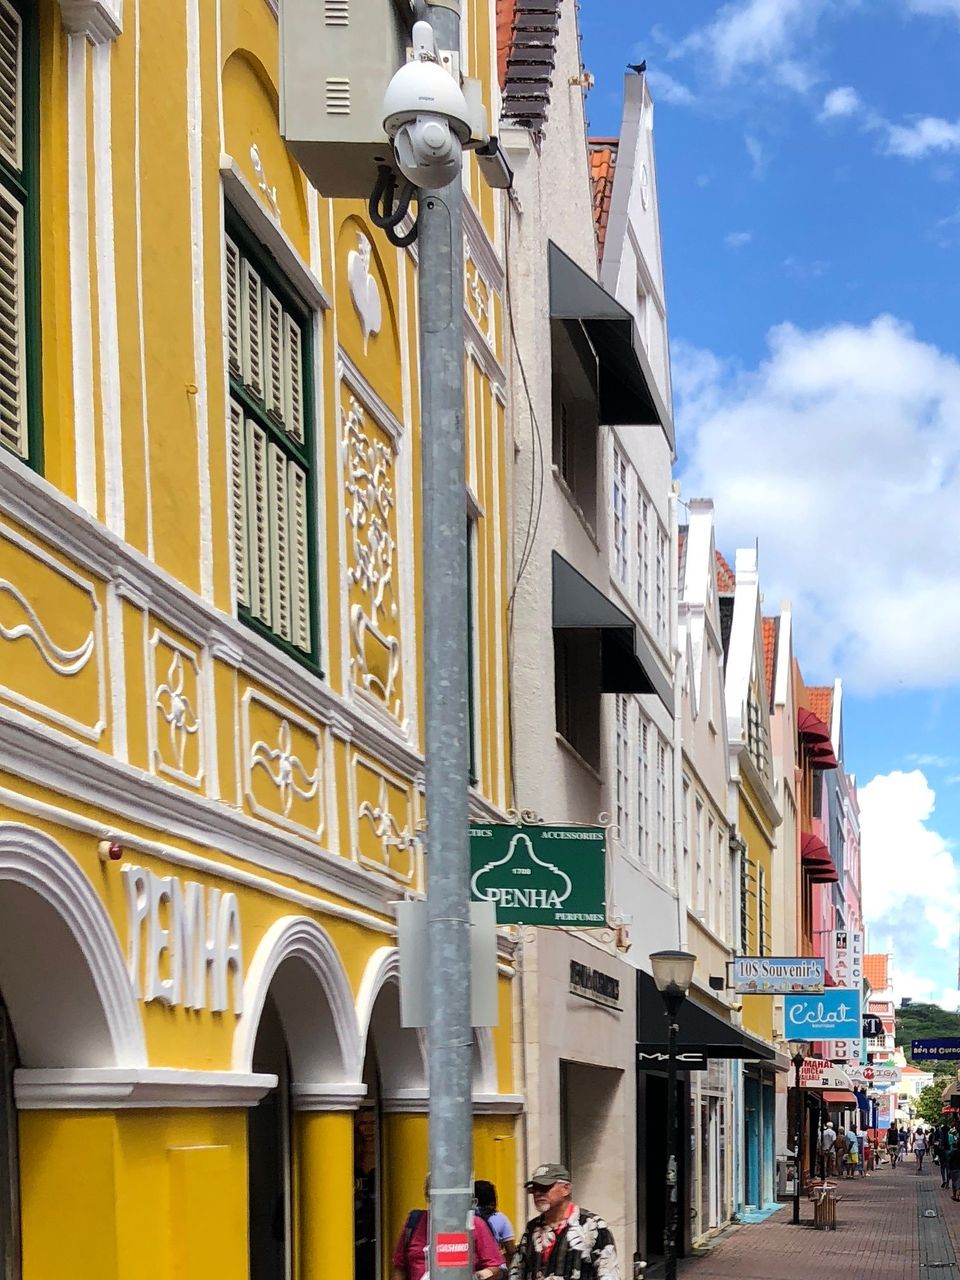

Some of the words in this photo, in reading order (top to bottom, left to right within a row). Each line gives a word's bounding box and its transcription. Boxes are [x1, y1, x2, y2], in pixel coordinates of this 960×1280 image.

[540, 831, 604, 841] ACCESSORIES
[485, 887, 564, 909] PENHA
[554, 912, 605, 922] PERFUMES
[120, 863, 244, 1015] PENHA
[761, 960, 821, 978] Souvenir's
